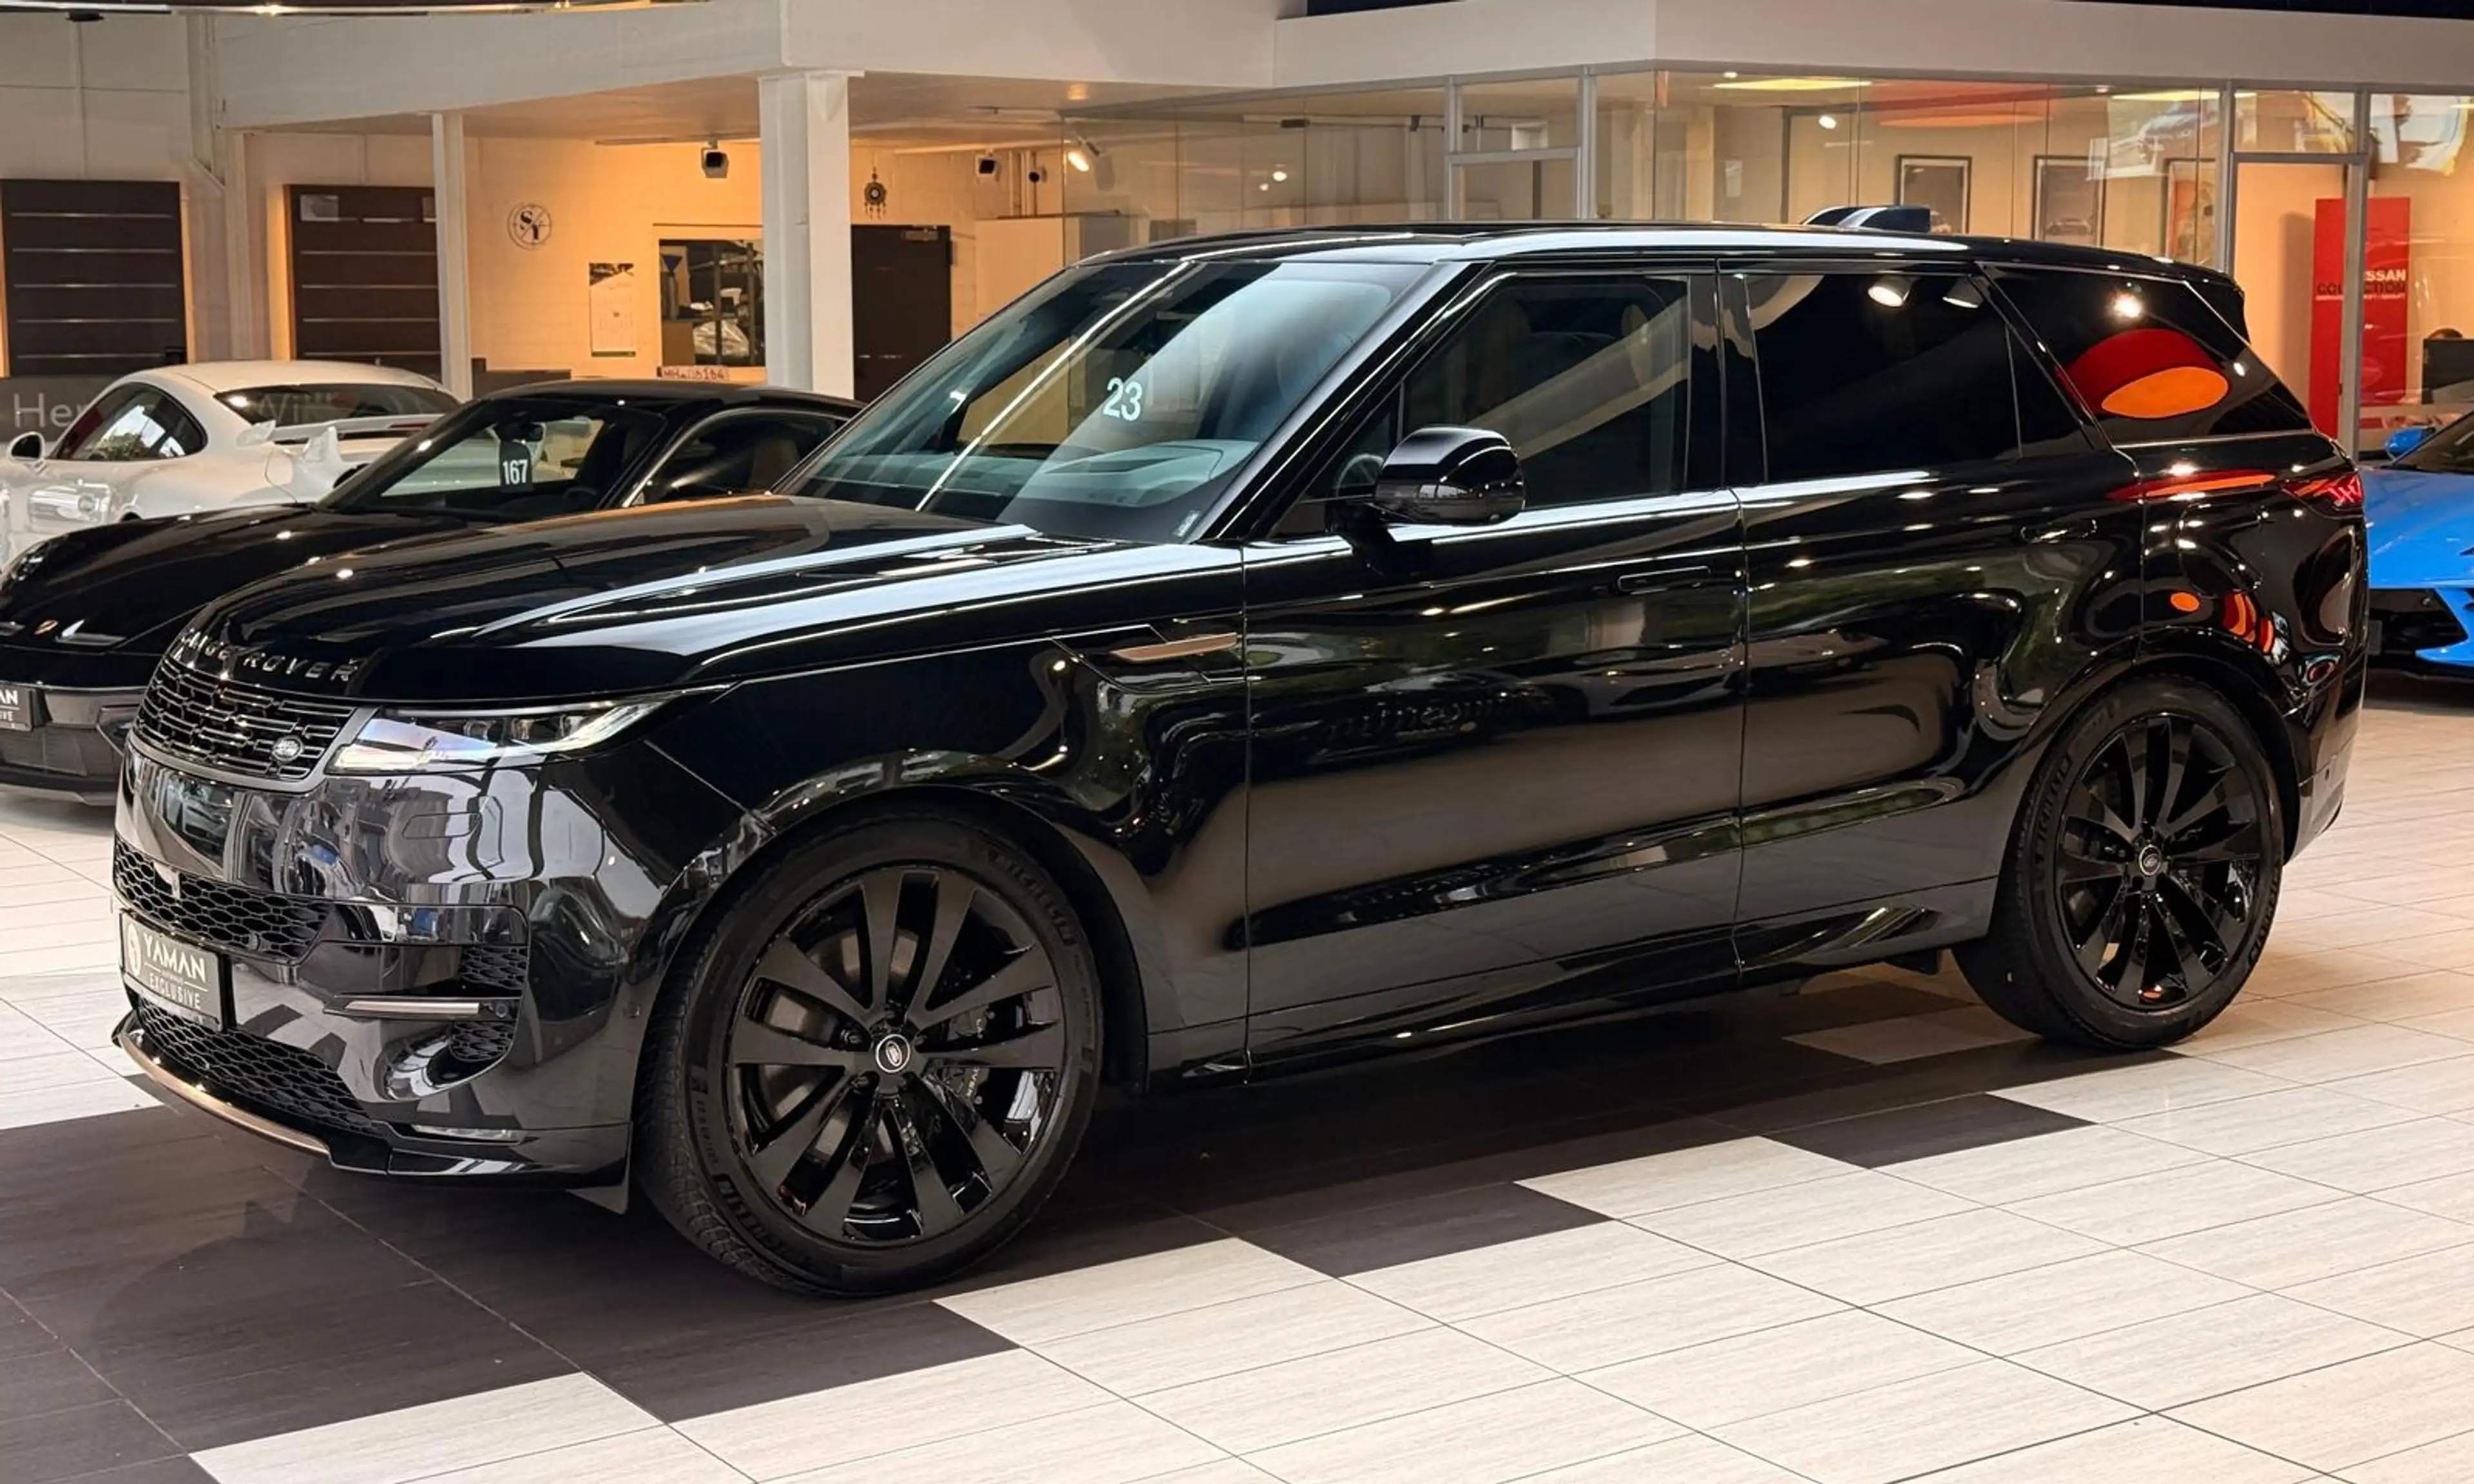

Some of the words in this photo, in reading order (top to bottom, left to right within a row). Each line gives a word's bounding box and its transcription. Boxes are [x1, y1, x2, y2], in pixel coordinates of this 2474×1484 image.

[1103, 377, 1142, 421] 23
[503, 459, 528, 485] 167
[242, 652, 358, 681] ROVER
[144, 932, 207, 984] YAMAN
[149, 972, 202, 1011] EXCLUSIVE
